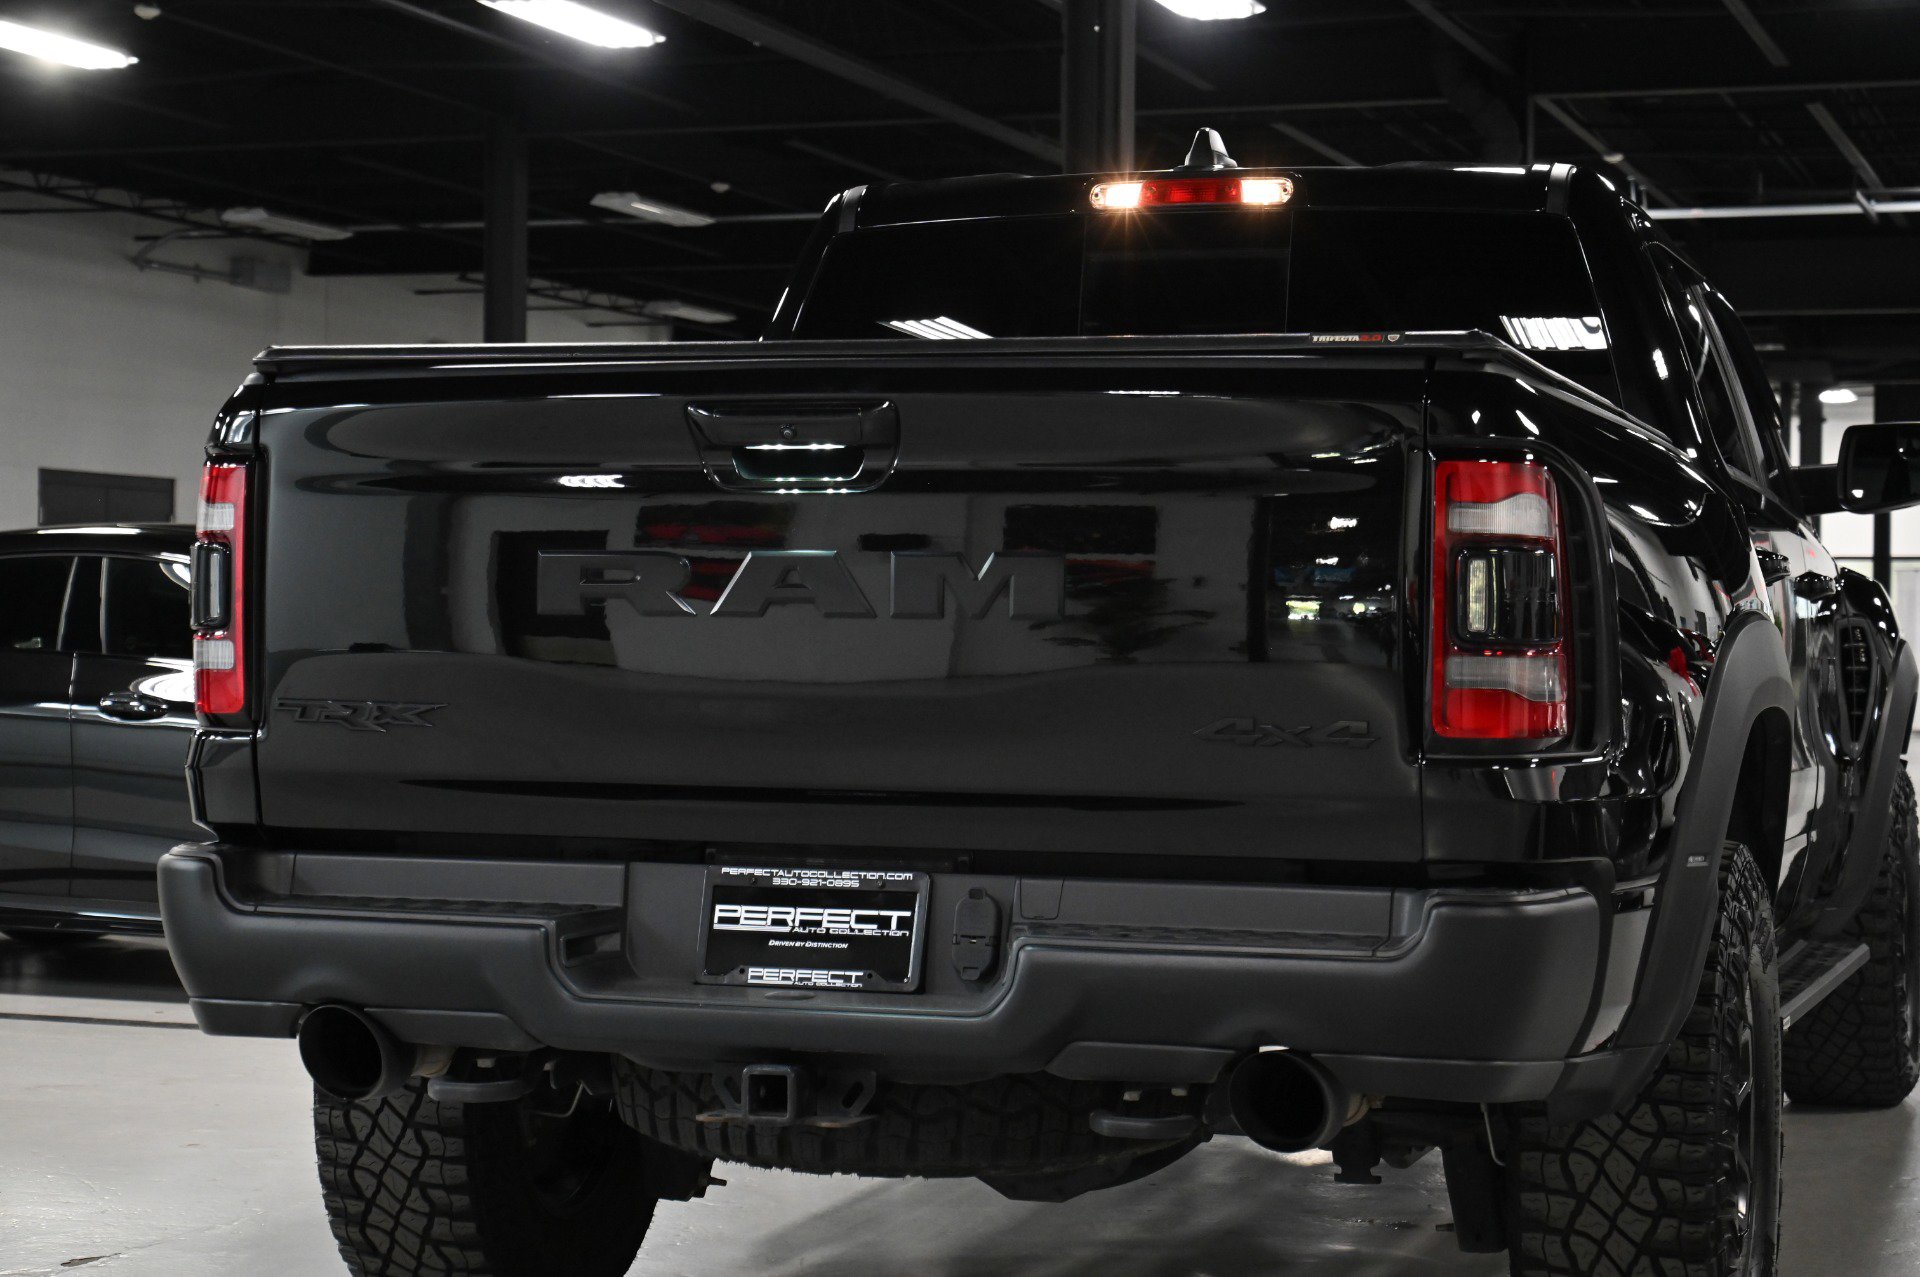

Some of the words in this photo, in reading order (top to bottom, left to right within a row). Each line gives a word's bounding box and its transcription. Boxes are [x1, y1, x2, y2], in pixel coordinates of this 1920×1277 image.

[536, 550, 1065, 619] RAM
[274, 698, 449, 733] TRX
[721, 867, 913, 881] PERFECTAUTOCOLLECTION.COM
[772, 877, 860, 888] 330-921-0895
[713, 904, 912, 931] PERFECT
[792, 926, 826, 934] AUTO
[829, 927, 909, 937] COLLECTION
[747, 967, 864, 984] PERFECT
